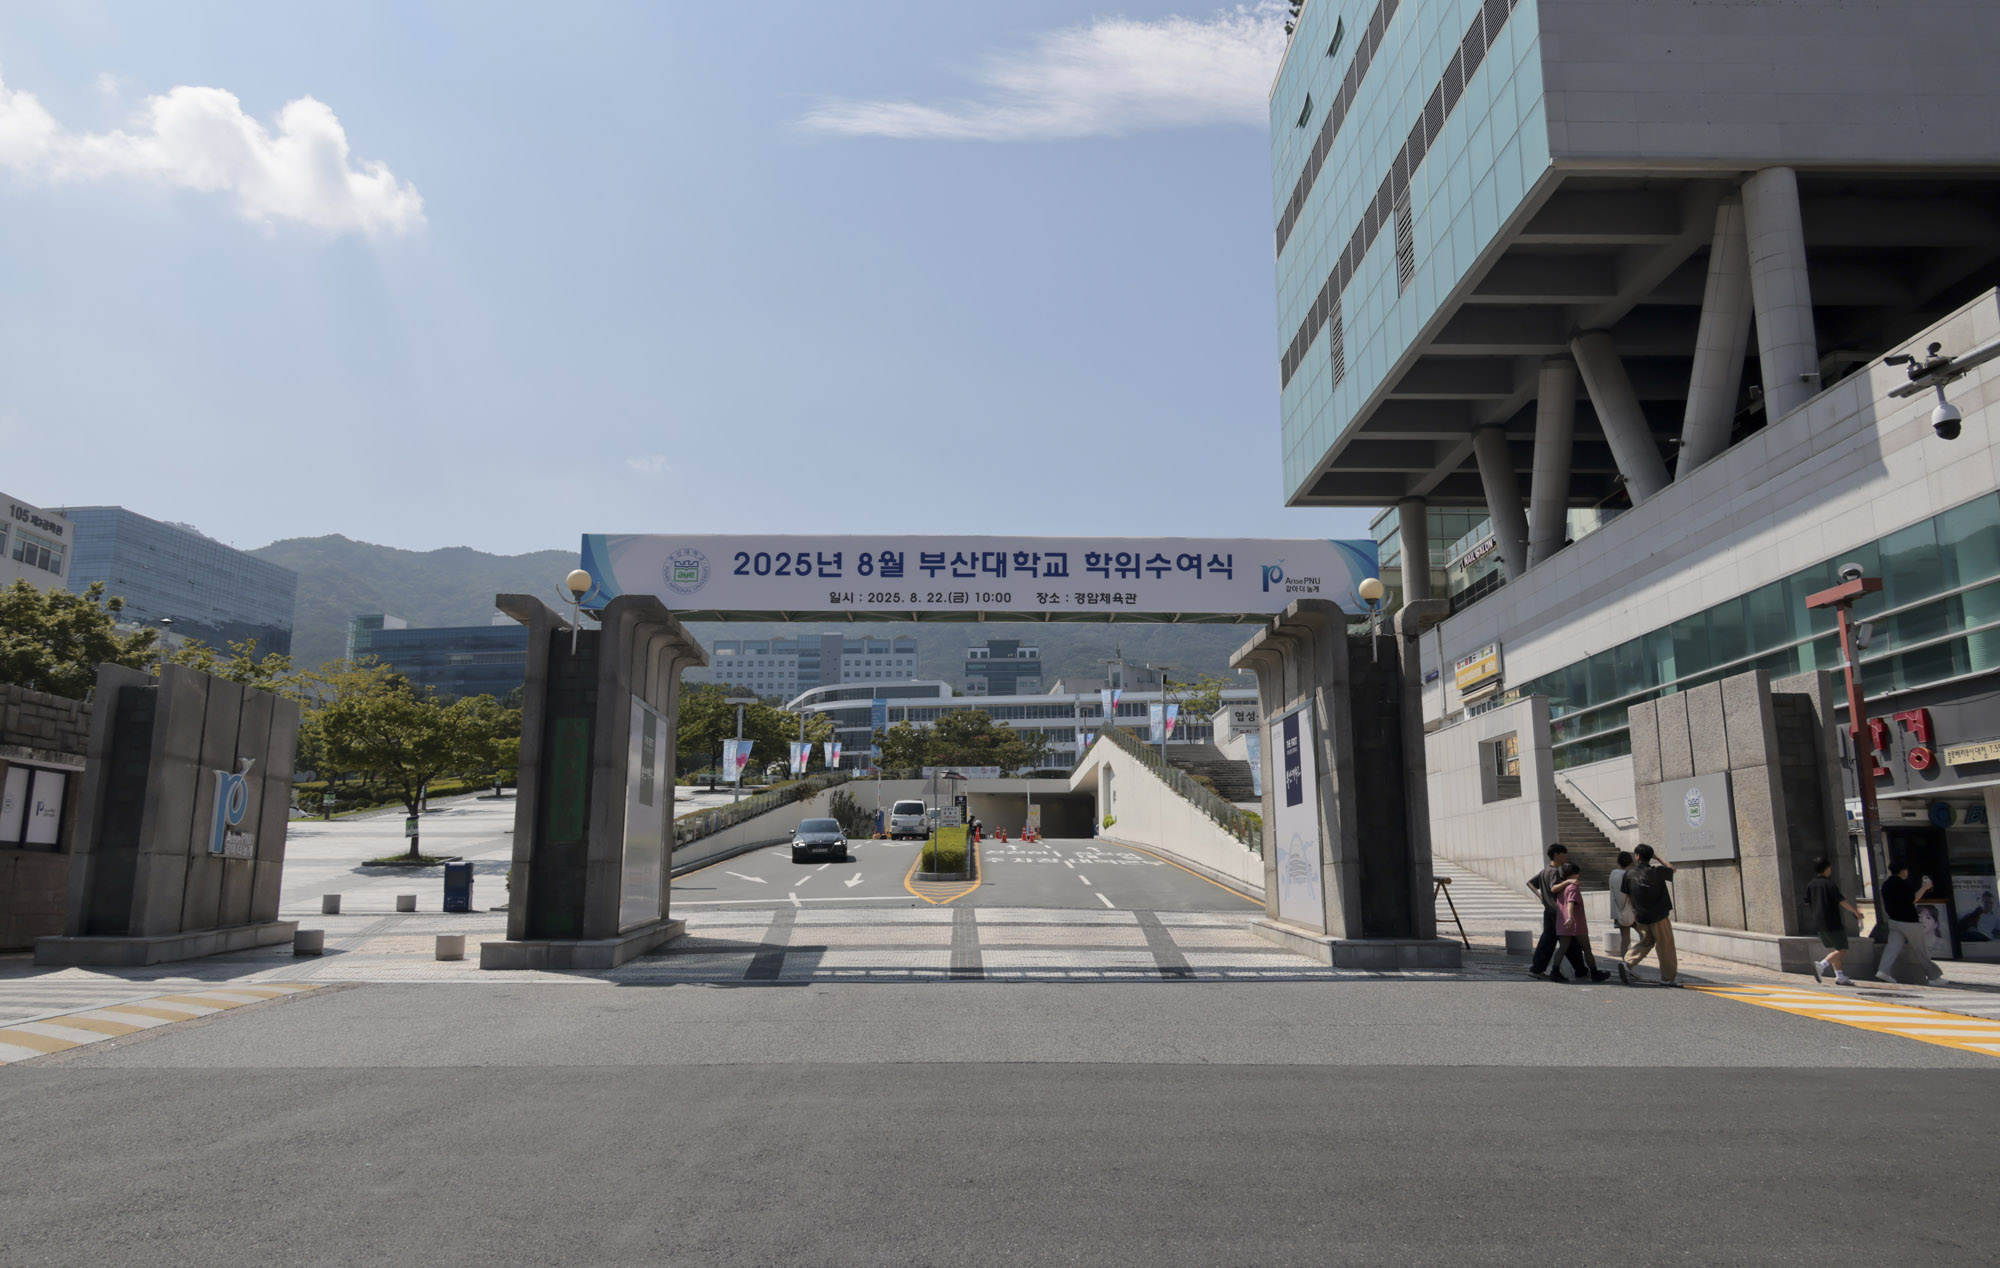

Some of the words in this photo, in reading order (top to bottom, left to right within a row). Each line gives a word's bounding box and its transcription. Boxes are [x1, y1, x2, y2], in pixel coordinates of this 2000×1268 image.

[10, 504, 30, 523] 105
[1463, 551, 1475, 567] NAIL
[1475, 538, 1493, 558] SALON
[733, 551, 843, 578] 2025년
[857, 551, 905, 578] 8월
[919, 551, 1070, 579] 부산대학교
[1084, 551, 1233, 580] 학위수여식
[1285, 585, 1299, 593] 같이
[829, 591, 854, 604] 일시
[867, 592, 905, 604] 2025.
[909, 592, 922, 604] 8.
[926, 591, 969, 604] 22.(금)
[975, 592, 1012, 603] 10:00
[1036, 592, 1061, 605] 장소
[1074, 592, 1138, 605] 경암체육관
[1234, 711, 1259, 722] 협성
